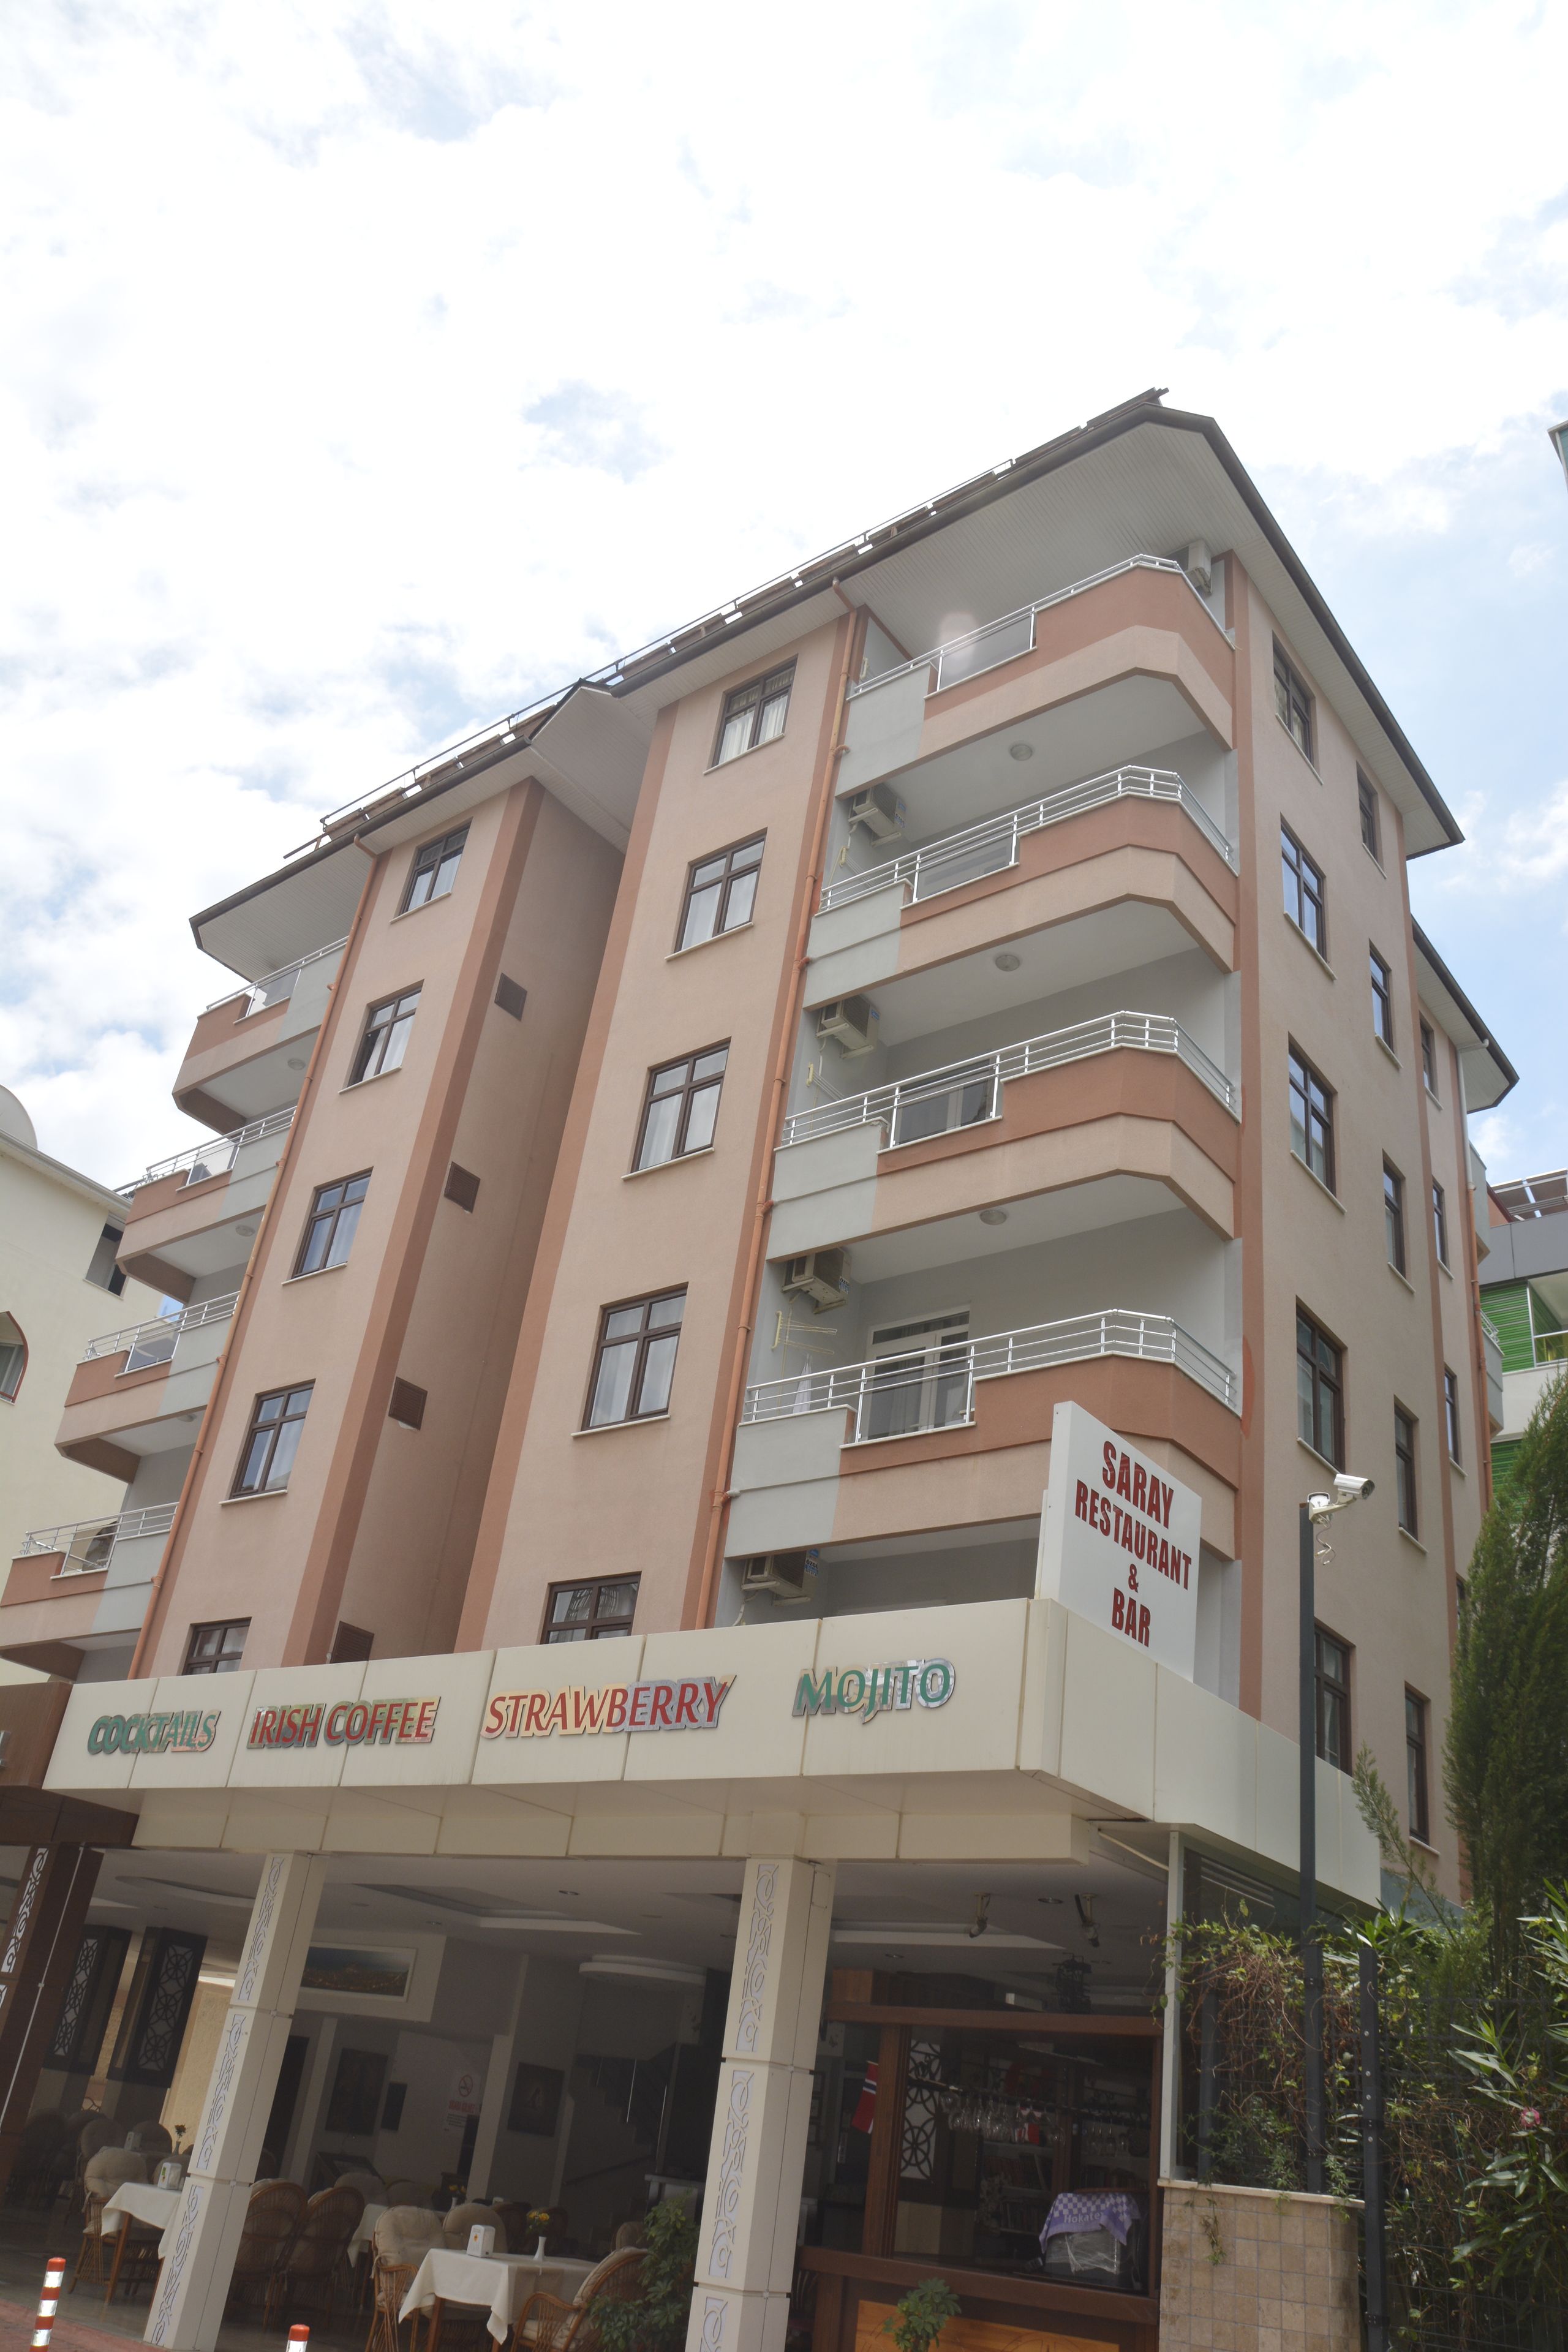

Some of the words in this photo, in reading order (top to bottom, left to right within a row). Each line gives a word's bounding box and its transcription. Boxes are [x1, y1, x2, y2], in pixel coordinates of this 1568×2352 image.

[1102, 1441, 1174, 1529] SARAY
[1075, 1479, 1192, 1591] RESTAURANT
[1128, 1563, 1139, 1593] &
[1111, 1587, 1151, 1648] BAR
[483, 1679, 732, 1736] STRAWBERRY
[794, 1661, 952, 1720] MOJITO
[88, 1713, 219, 1753] COCKTAILS
[248, 1705, 324, 1746] IRISH
[325, 1699, 437, 1743] COFFEE
